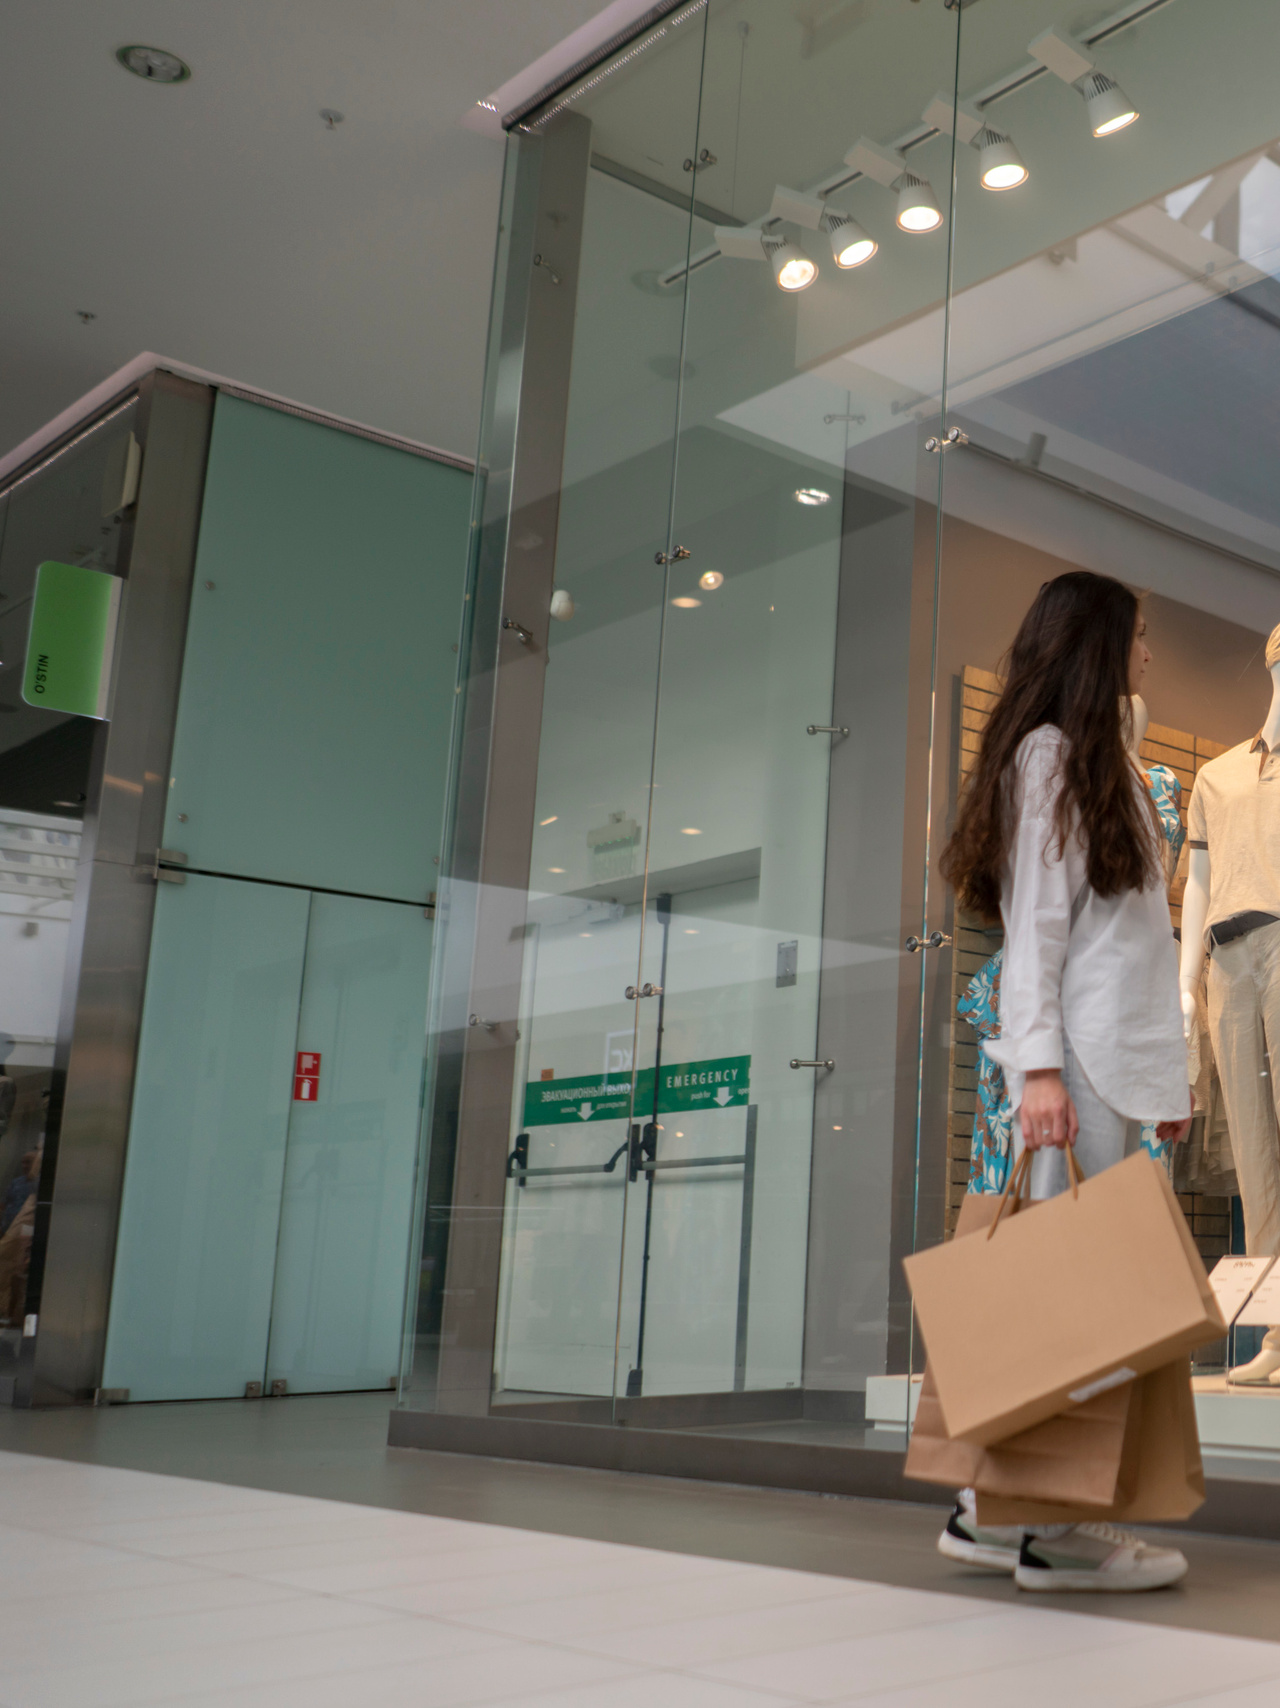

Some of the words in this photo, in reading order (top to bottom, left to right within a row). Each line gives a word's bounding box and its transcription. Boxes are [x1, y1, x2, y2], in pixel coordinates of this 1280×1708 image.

[34, 654, 49, 694] O'STIN
[606, 1082, 632, 1096] ВЫХО
[666, 1068, 739, 1089] EMERGENCY
